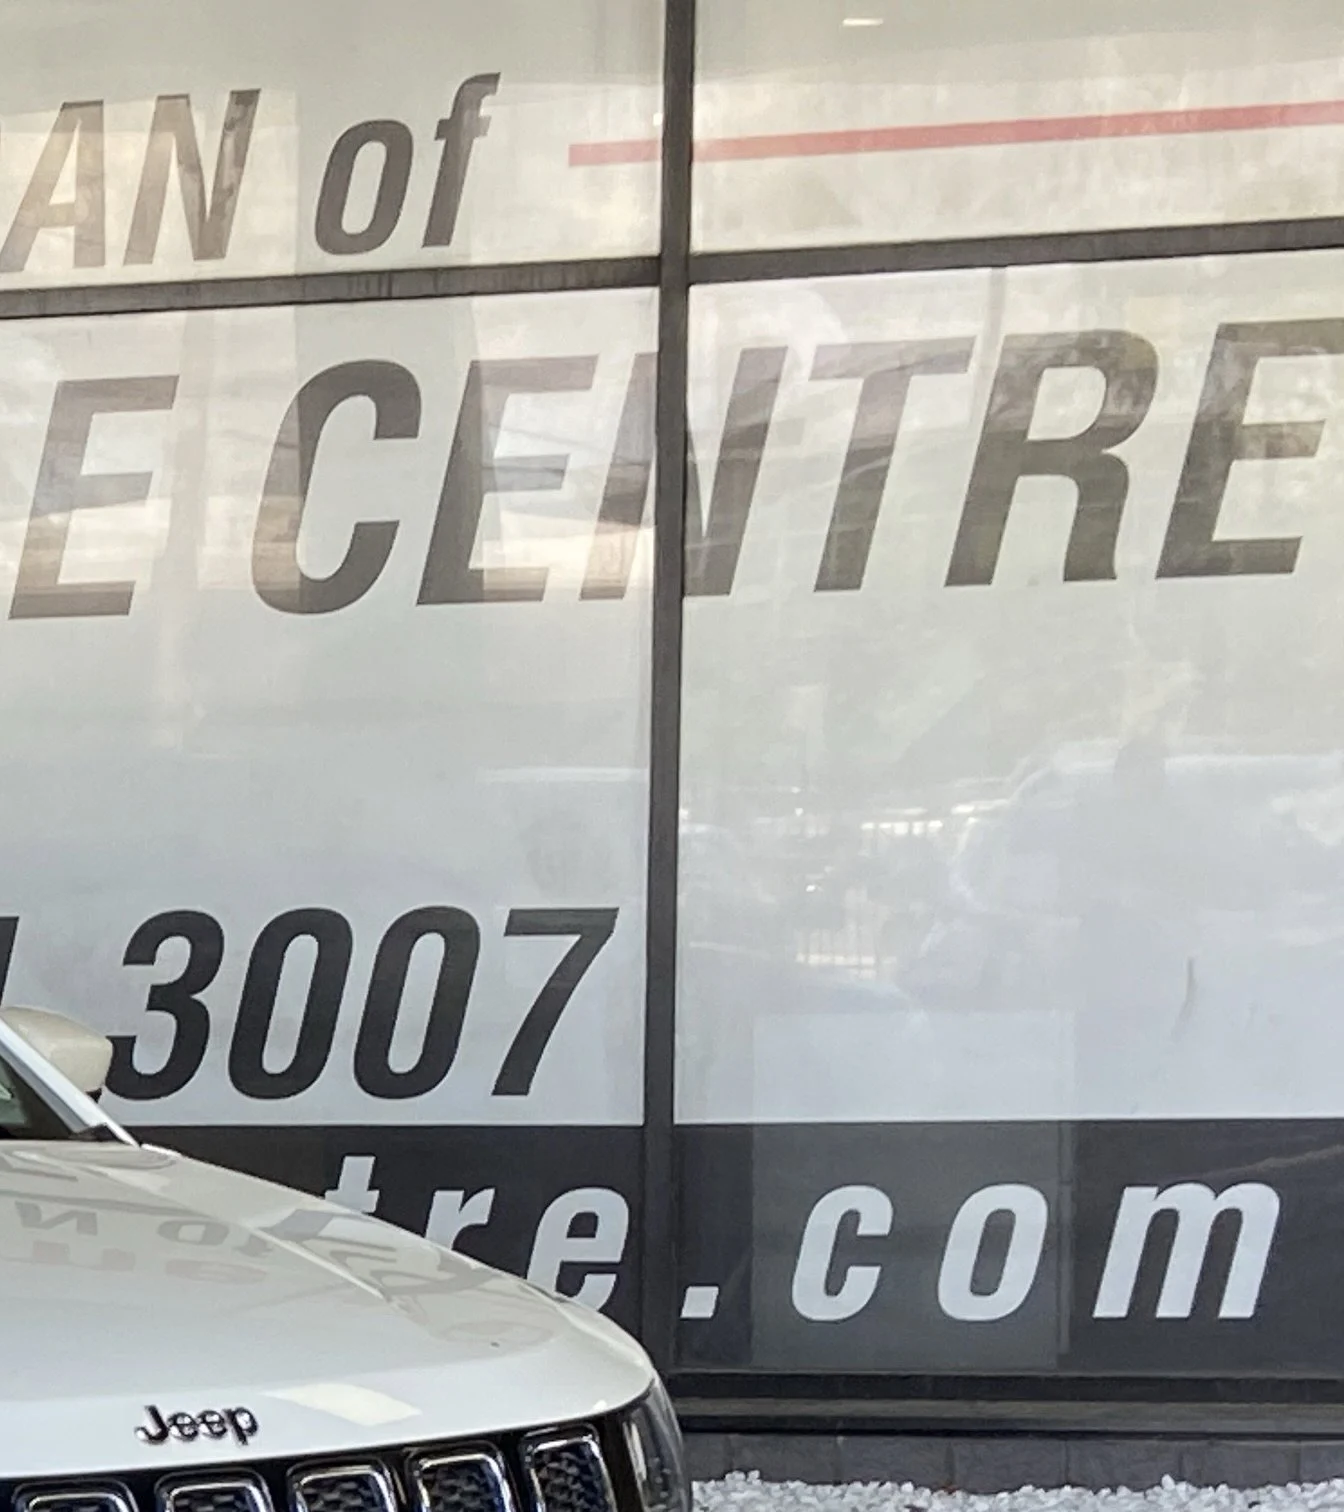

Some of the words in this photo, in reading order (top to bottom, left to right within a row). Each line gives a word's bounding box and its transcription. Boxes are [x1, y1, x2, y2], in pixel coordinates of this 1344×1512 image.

[313, 71, 502, 256] of
[250, 316, 1344, 615] CENTRE
[105, 905, 619, 1103] 3007
[133, 1404, 259, 1446] Jeep
